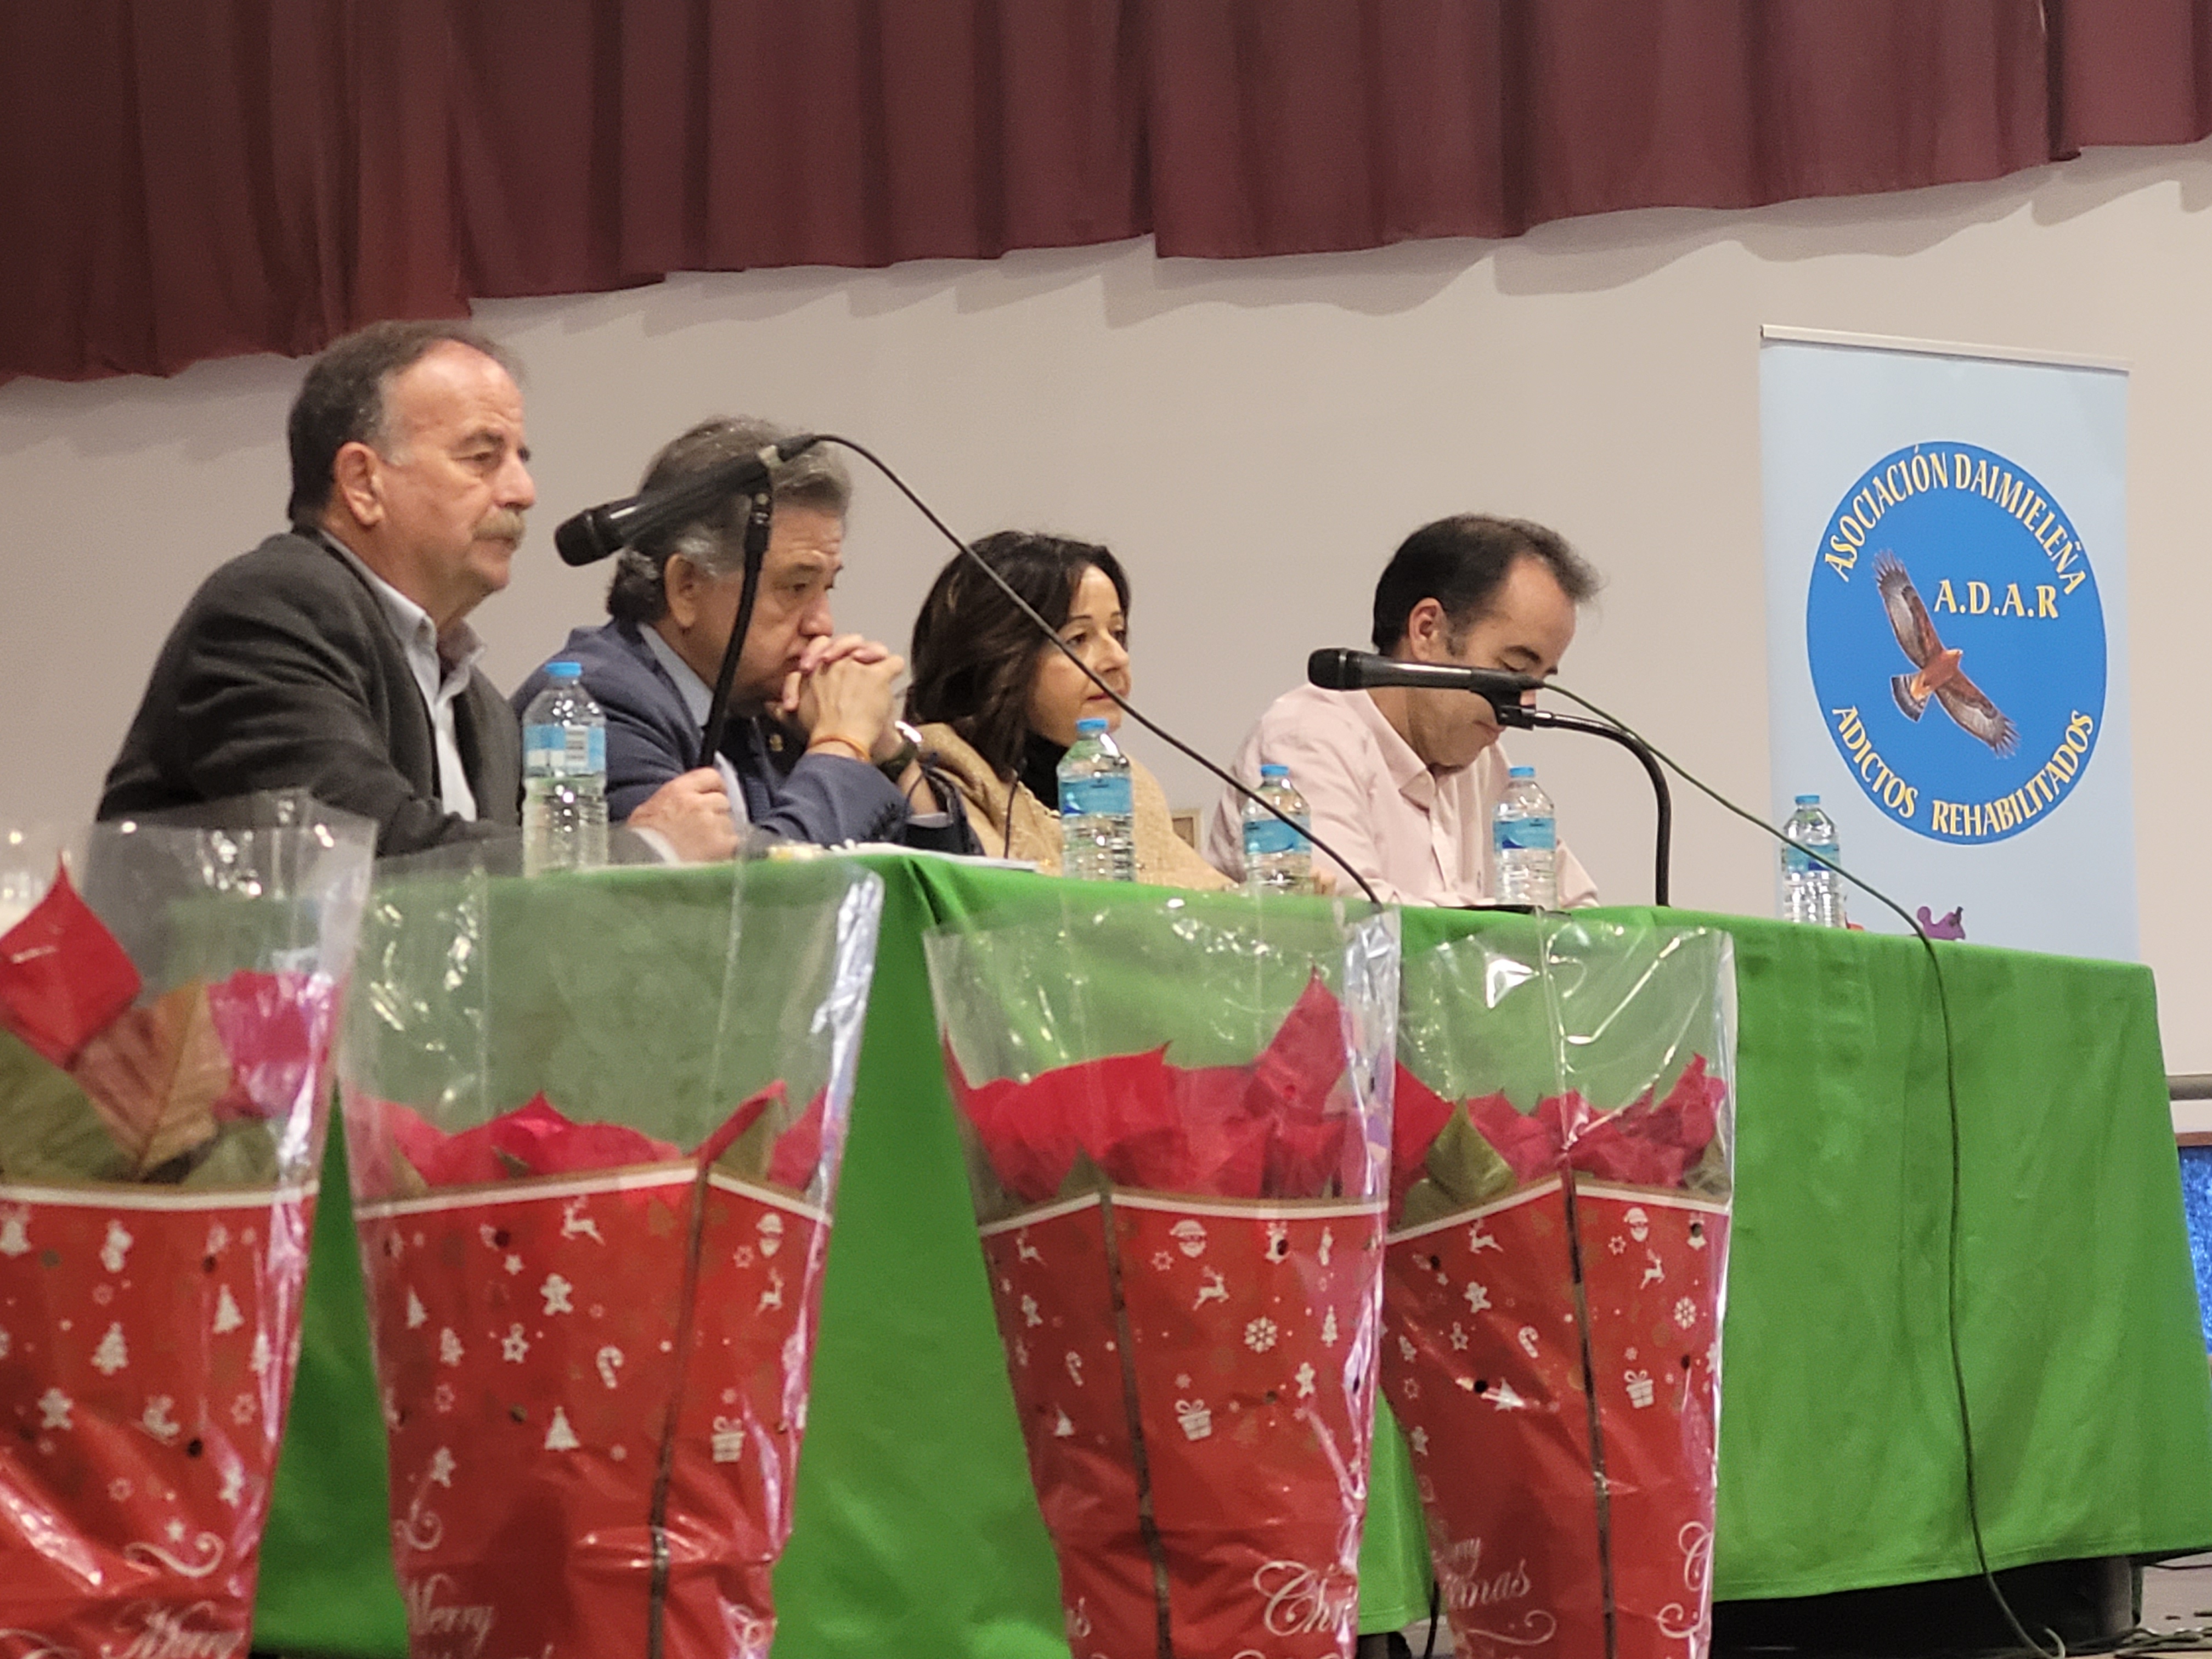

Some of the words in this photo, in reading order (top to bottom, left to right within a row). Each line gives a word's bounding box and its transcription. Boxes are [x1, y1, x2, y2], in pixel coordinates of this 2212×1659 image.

[1824, 444, 1949, 582] ASOCIACIÓN
[1954, 453, 2086, 595] DAIMIELEÑA
[1934, 579, 2058, 619] A.D.A.R
[1832, 705, 1919, 819] ADICTOS
[1932, 710, 2094, 836] REHABILITADOS
